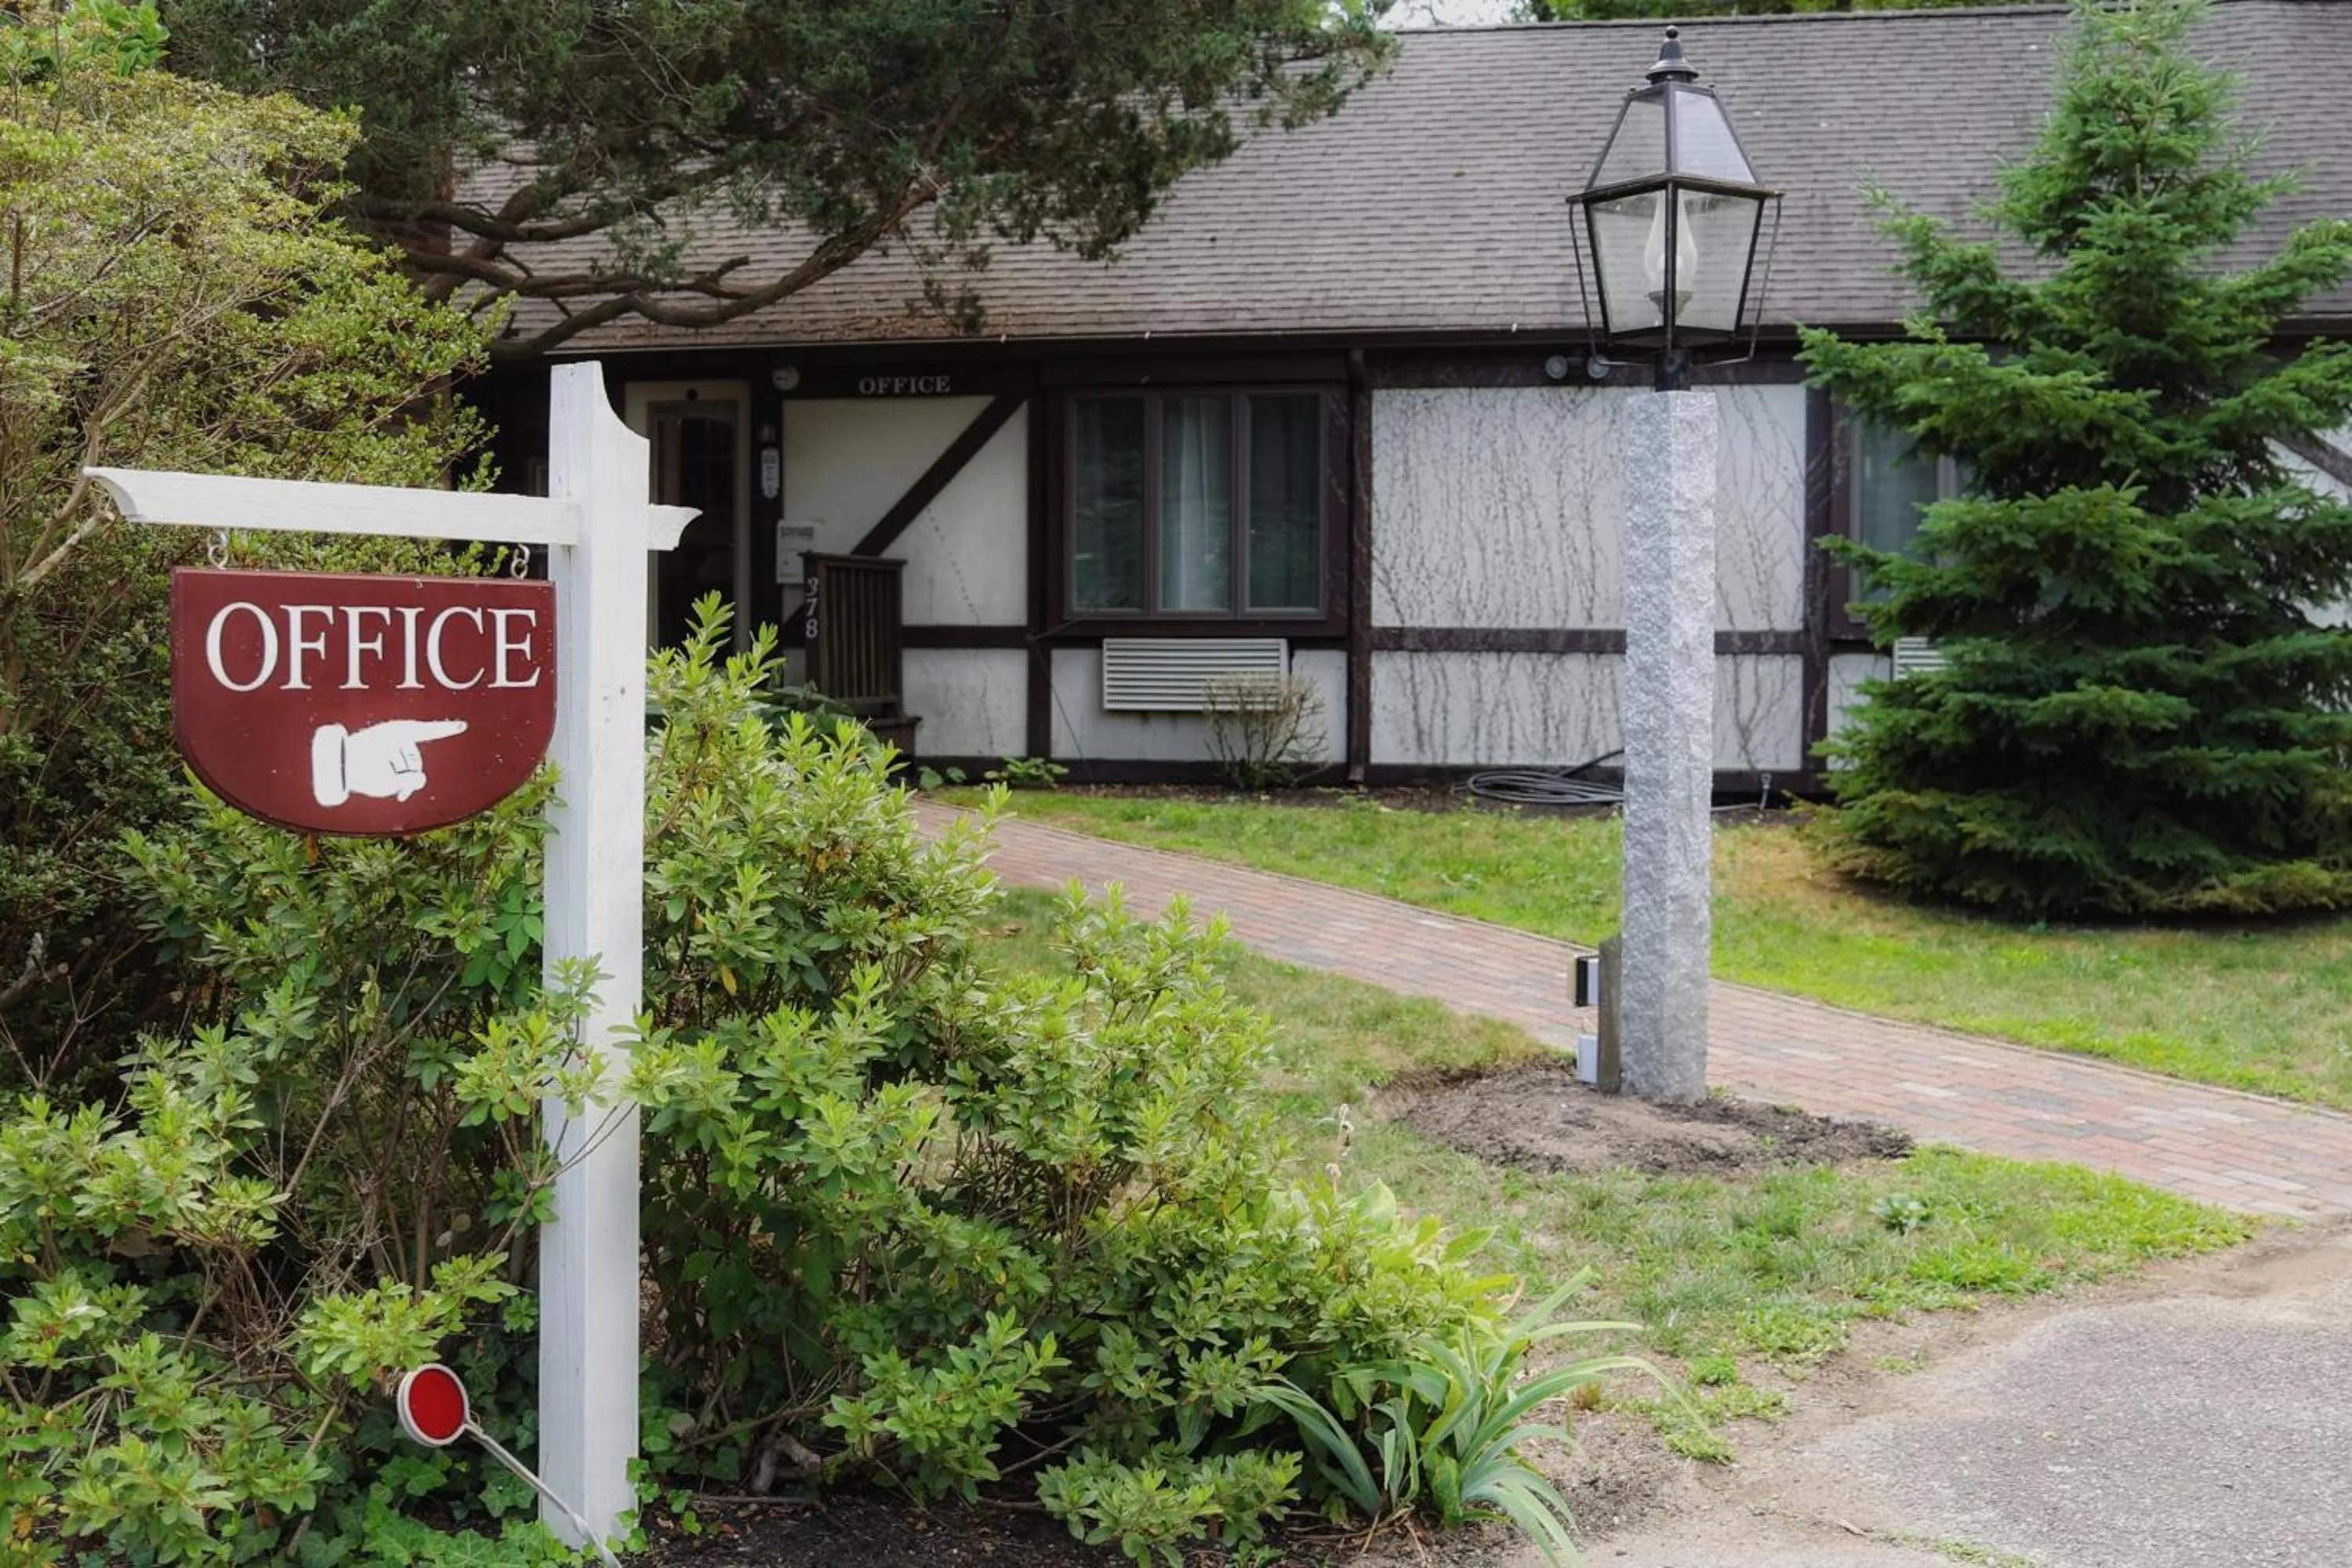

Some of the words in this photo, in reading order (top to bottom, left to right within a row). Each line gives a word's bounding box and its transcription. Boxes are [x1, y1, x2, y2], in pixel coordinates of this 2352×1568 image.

[858, 376, 951, 394] OFFICE
[805, 577, 819, 639] 378
[205, 601, 541, 691] OFFICE
